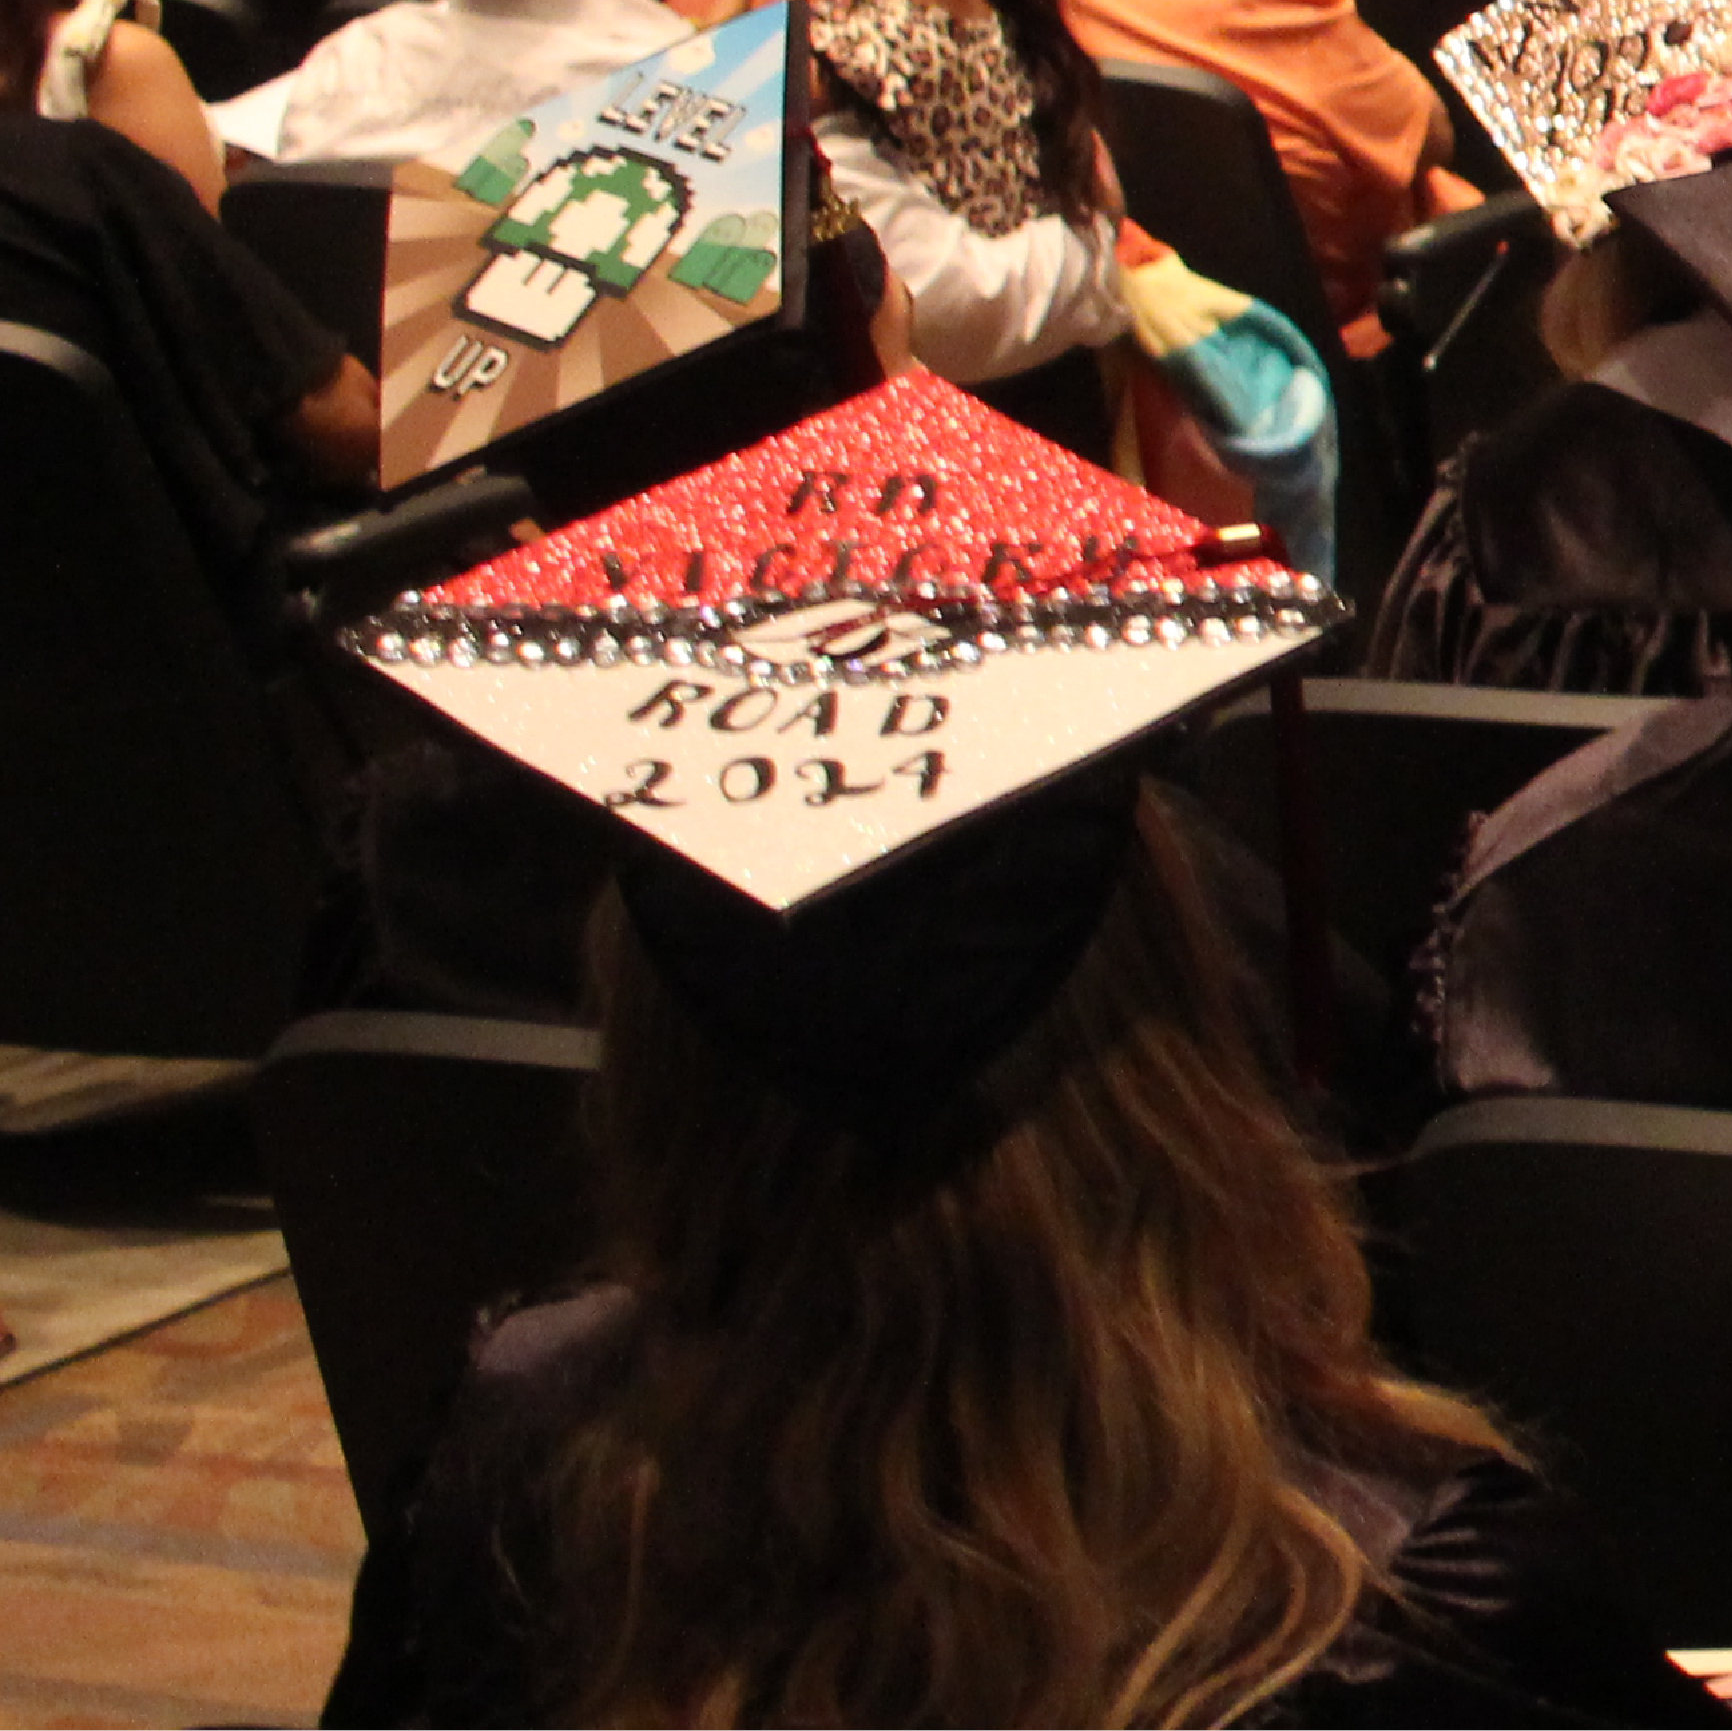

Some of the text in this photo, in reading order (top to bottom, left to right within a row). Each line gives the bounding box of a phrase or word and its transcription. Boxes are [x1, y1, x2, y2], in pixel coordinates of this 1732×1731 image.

[597, 71, 747, 162] LEVEL
[426, 333, 509, 401] UP
[626, 679, 951, 738] ROAD
[603, 749, 951, 811] 2024
